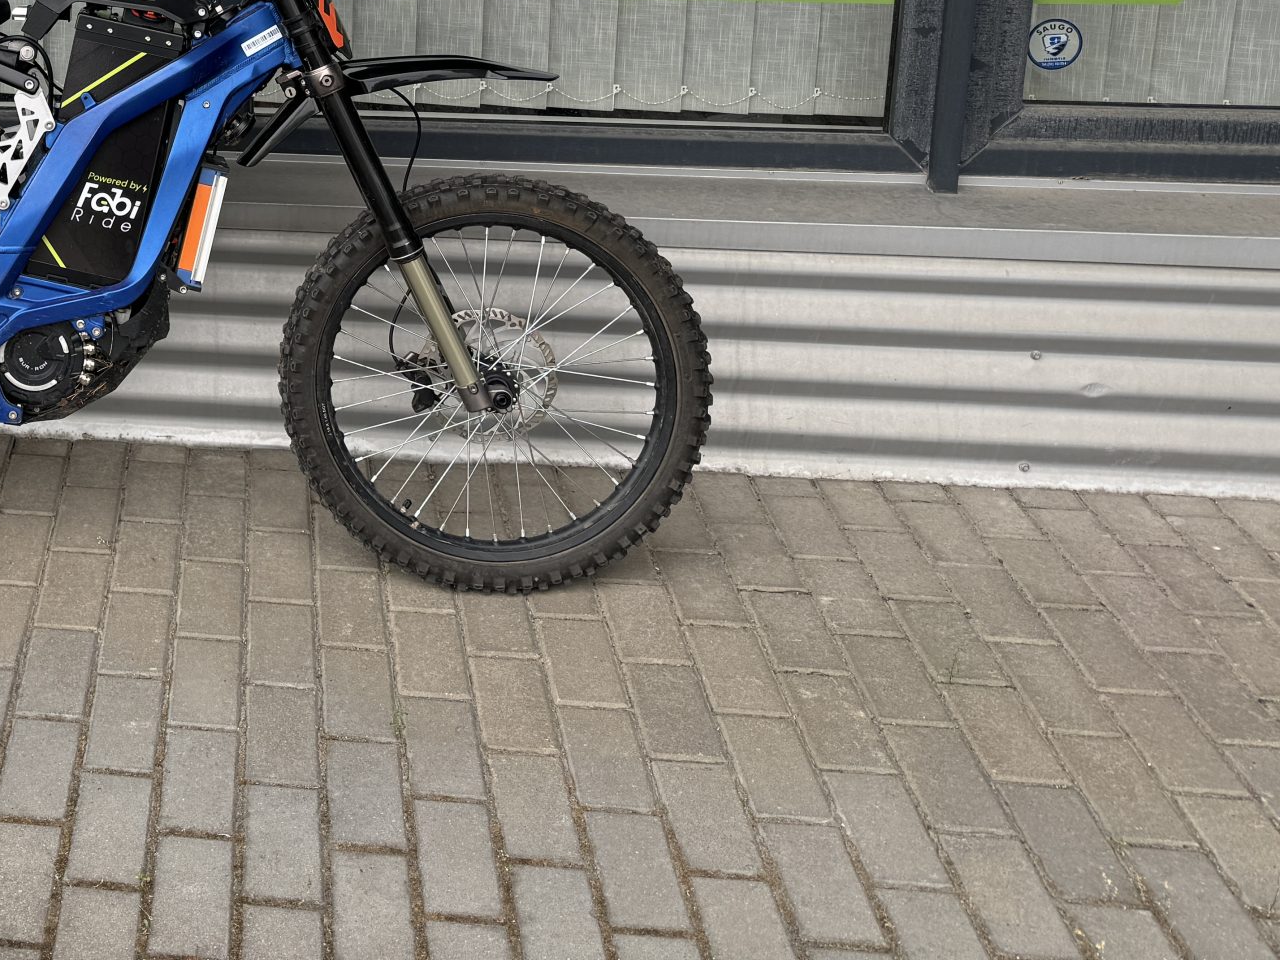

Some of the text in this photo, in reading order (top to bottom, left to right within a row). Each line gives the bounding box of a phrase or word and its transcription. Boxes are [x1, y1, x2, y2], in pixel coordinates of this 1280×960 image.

[1036, 23, 1073, 36] SAUGO
[87, 171, 142, 192] Powered by
[76, 182, 142, 219] Fabi
[70, 207, 132, 232] Ride
